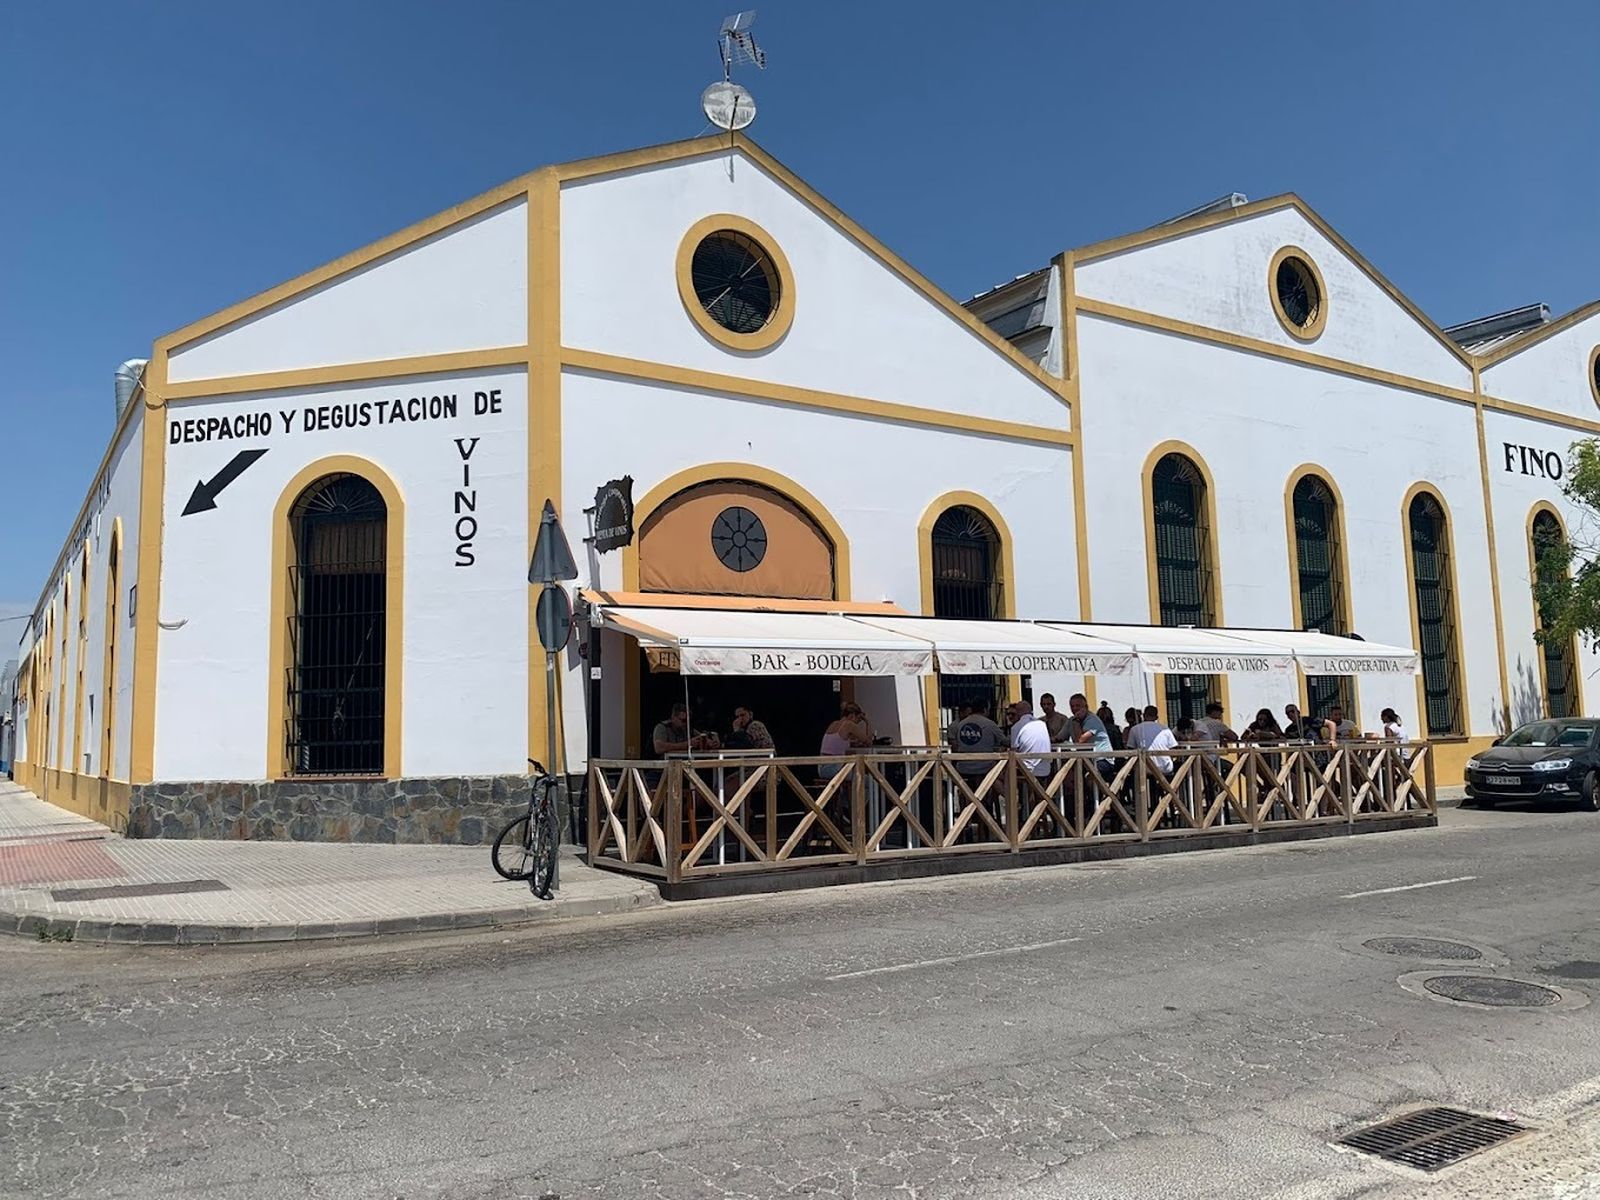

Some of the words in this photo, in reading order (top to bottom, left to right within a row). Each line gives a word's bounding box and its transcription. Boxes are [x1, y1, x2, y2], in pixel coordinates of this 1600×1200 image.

[170, 412, 272, 444] DESPACHO
[279, 409, 297, 434] Y
[304, 394, 457, 432] DEGUSTACION
[474, 389, 502, 415] DE
[1503, 442, 1563, 480] FINO
[453, 437, 480, 567] VINOS
[751, 653, 789, 671] BAR
[806, 654, 873, 671] BODEGA
[980, 655, 999, 670] LA
[1002, 656, 1098, 672] COOPERATIVA
[1168, 656, 1223, 671] DESPACHO
[1226, 658, 1237, 671] de
[1238, 658, 1270, 672] VINOS
[1323, 660, 1337, 671] LA
[1338, 660, 1399, 673] COOPERATIVA
[960, 730, 981, 740] NASA
